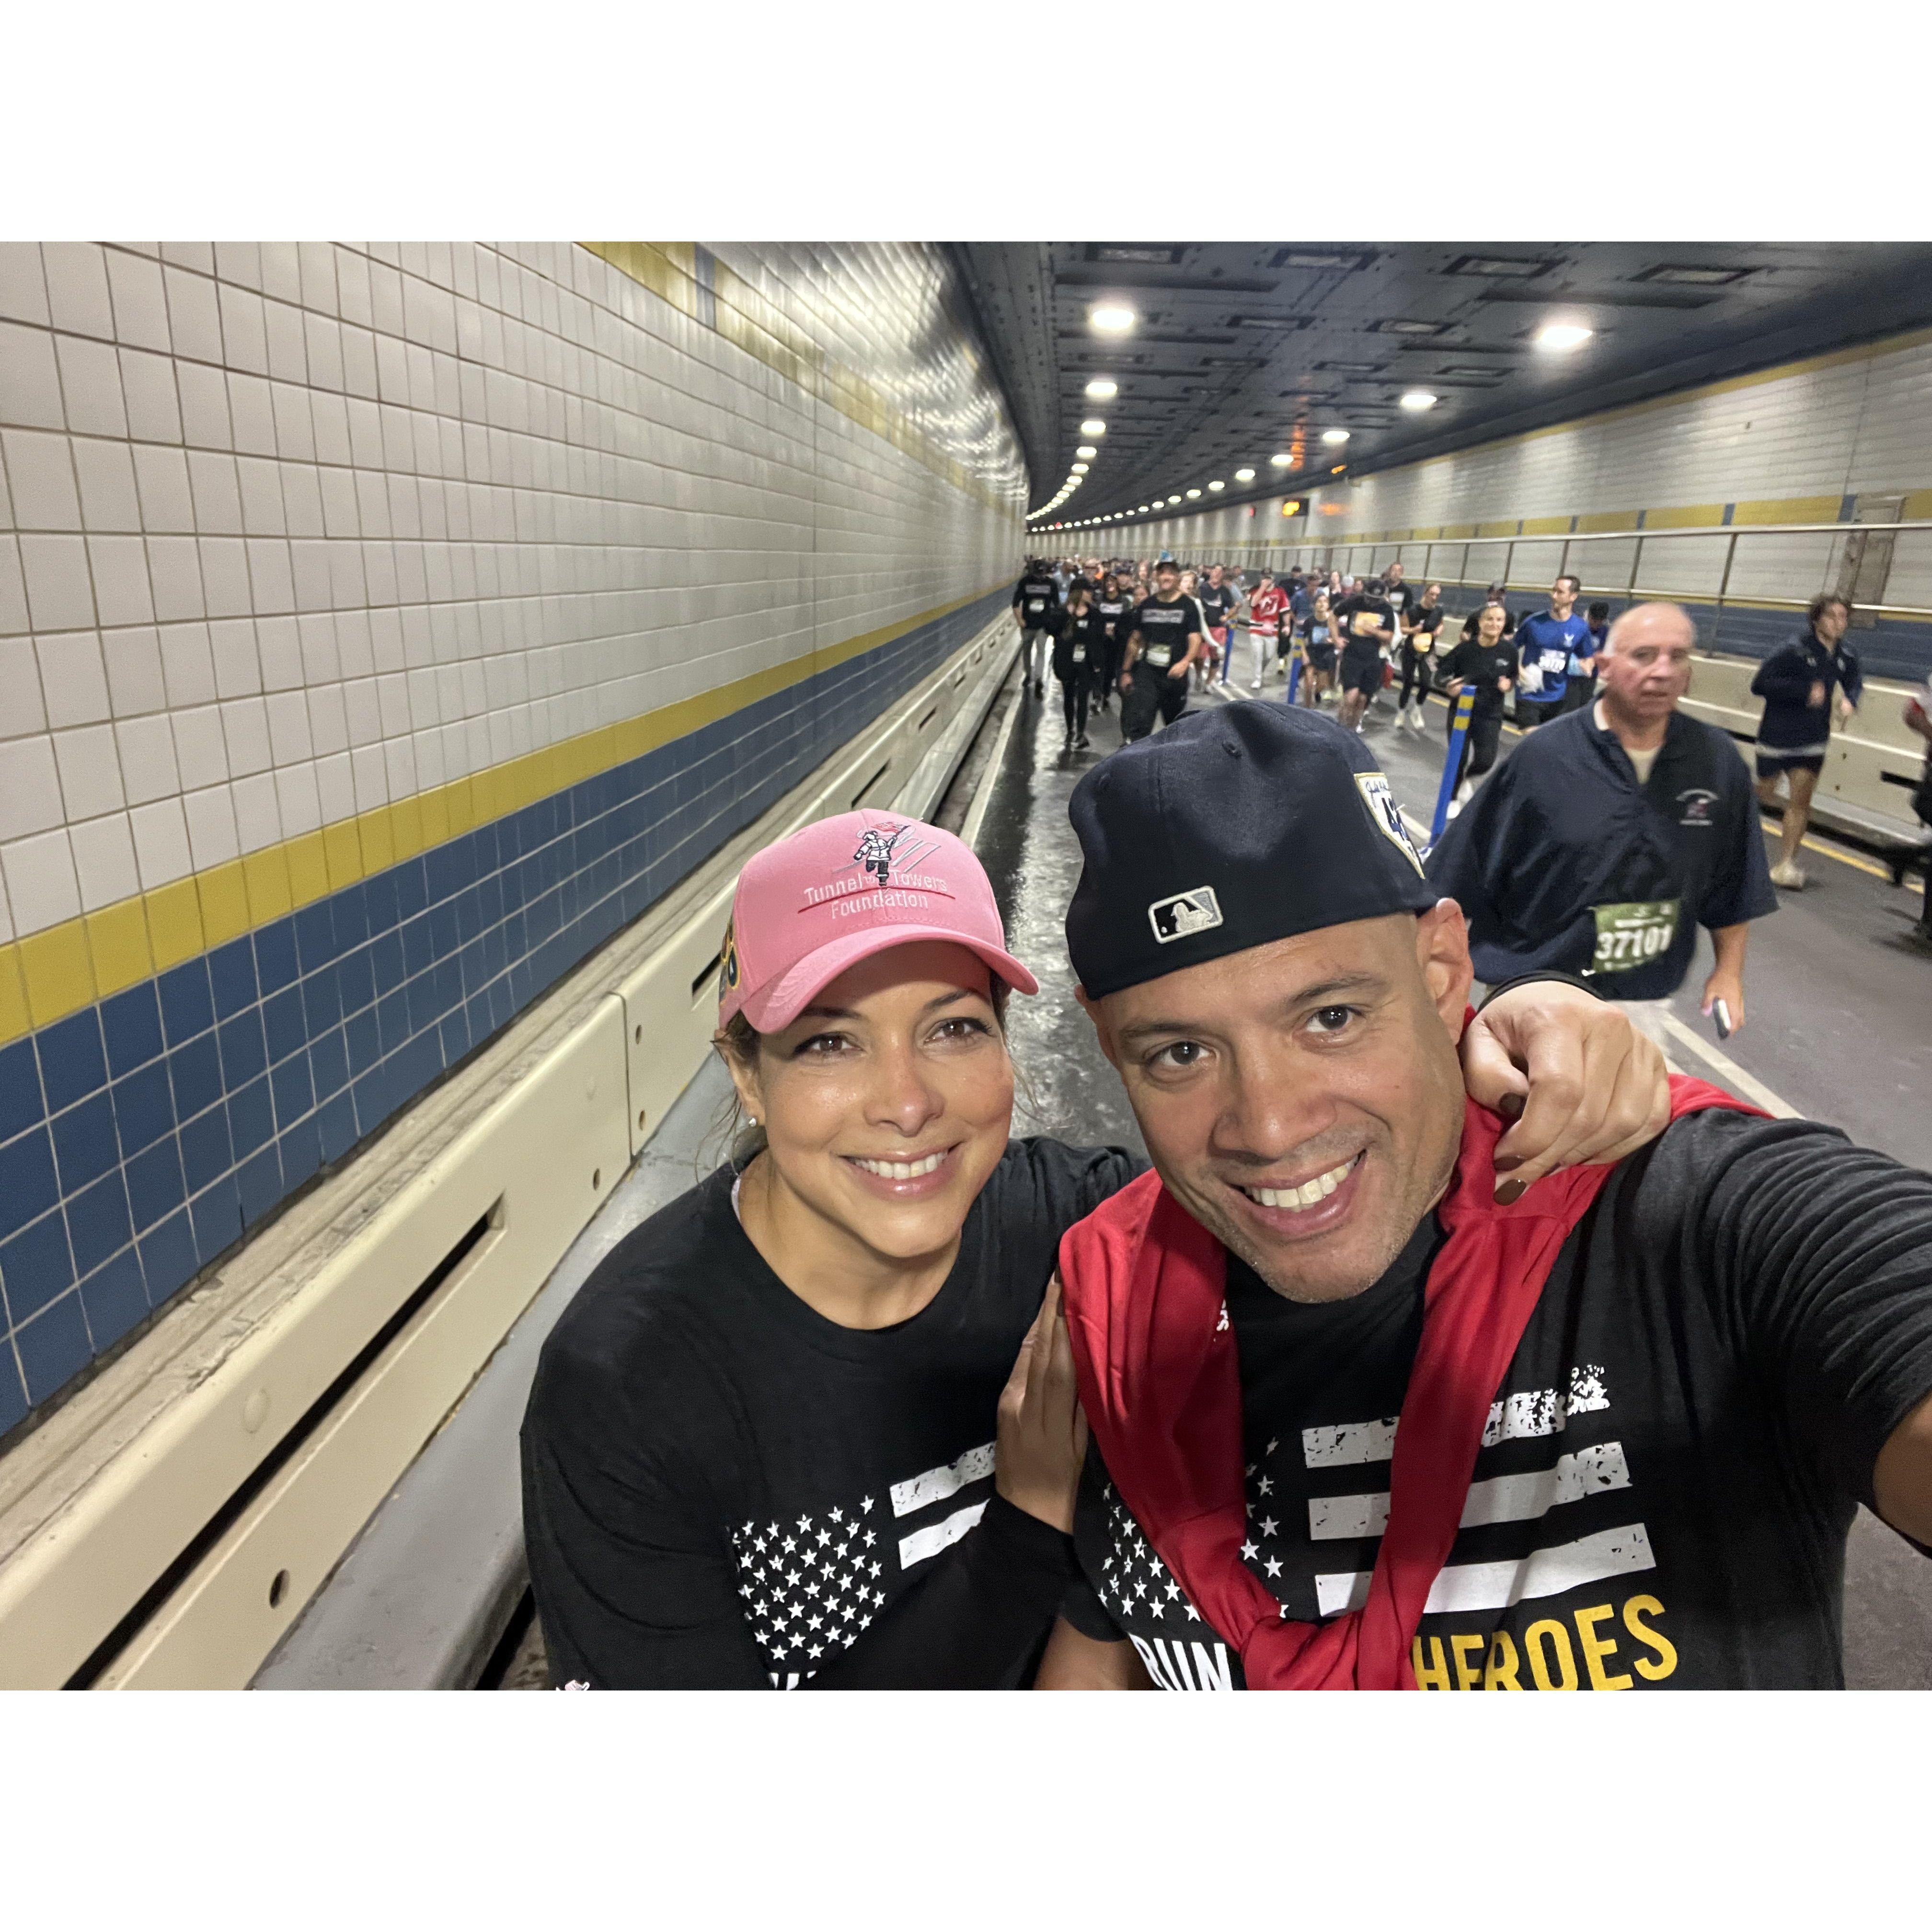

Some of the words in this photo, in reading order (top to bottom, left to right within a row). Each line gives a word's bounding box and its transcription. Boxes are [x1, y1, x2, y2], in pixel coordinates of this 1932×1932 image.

[804, 873, 862, 905] Tunnel
[888, 869, 947, 892] Towers
[829, 889, 929, 919] Foundation
[1595, 924, 1673, 960] 37101
[1413, 1594, 1678, 1690] HEROES
